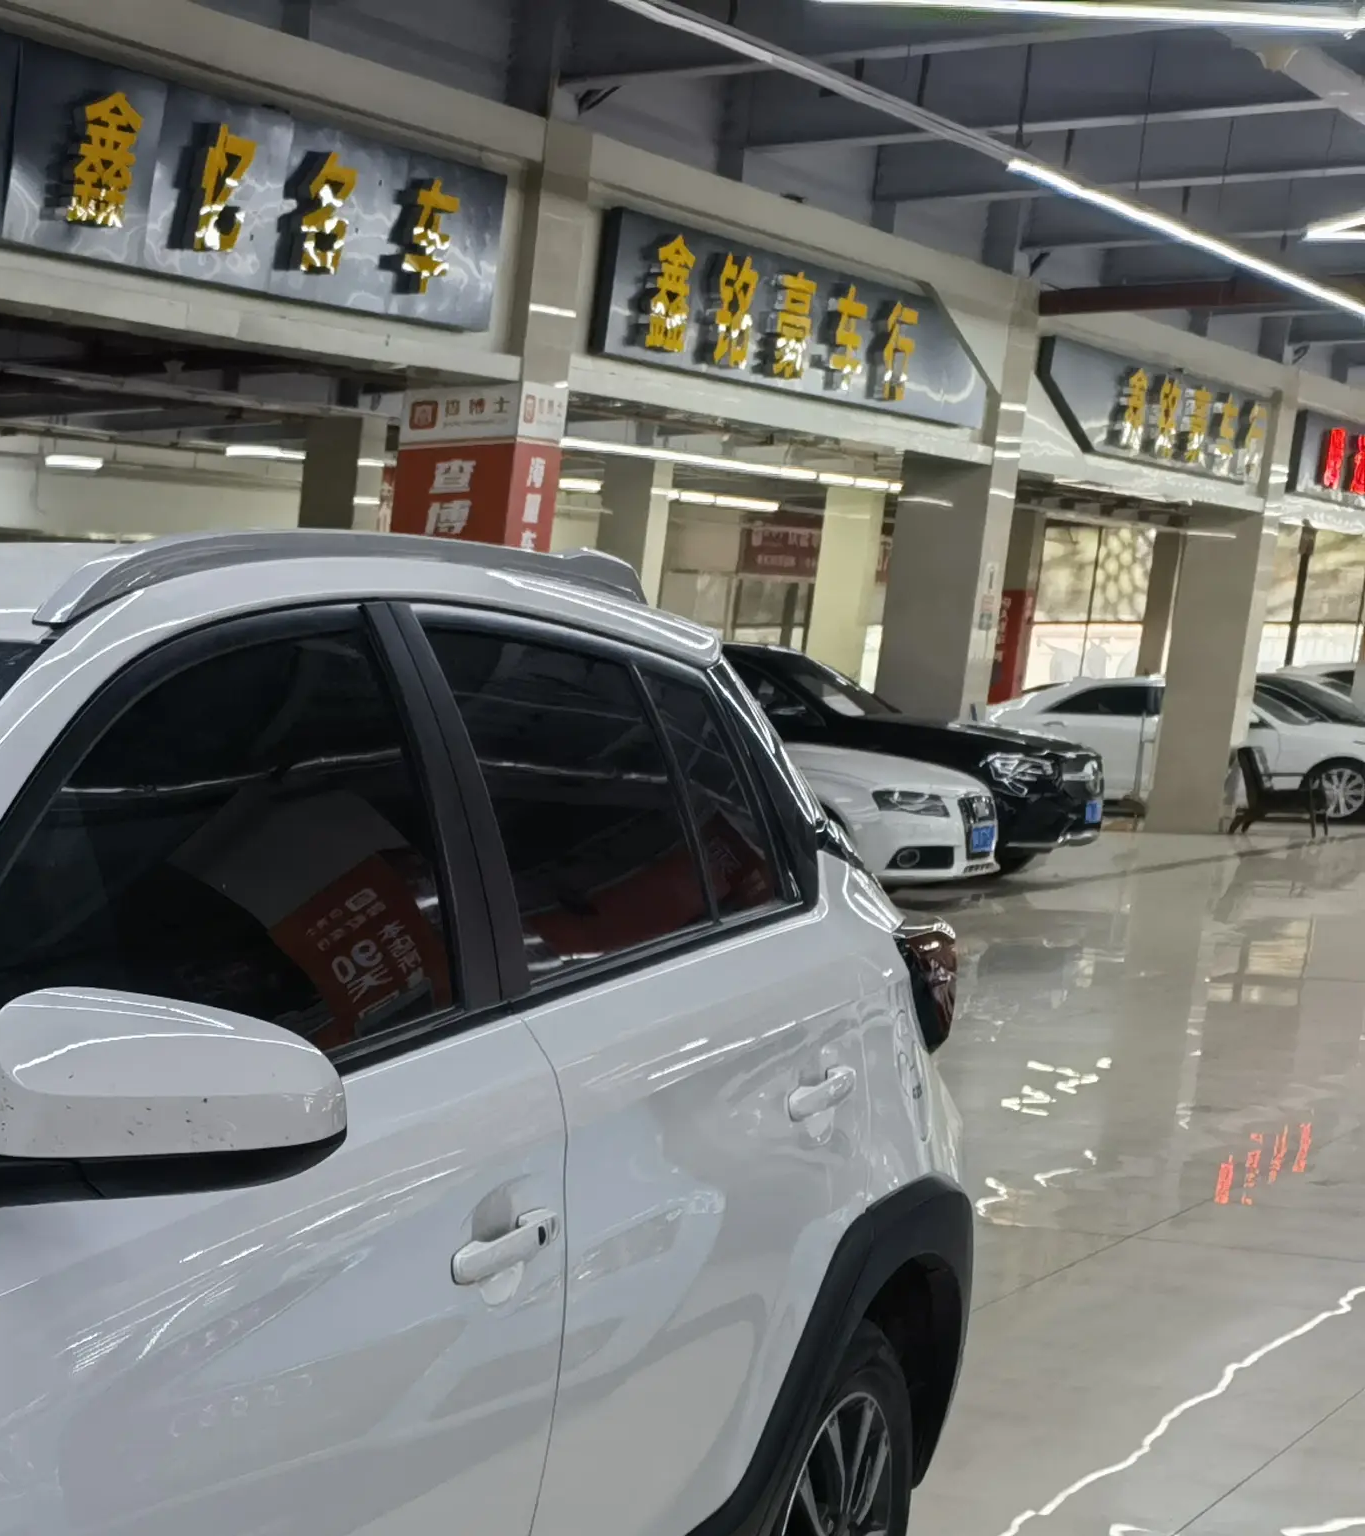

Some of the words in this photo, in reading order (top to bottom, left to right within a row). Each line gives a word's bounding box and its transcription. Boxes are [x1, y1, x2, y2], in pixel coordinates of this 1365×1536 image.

[645, 234, 919, 401] 鑫铭豪车行
